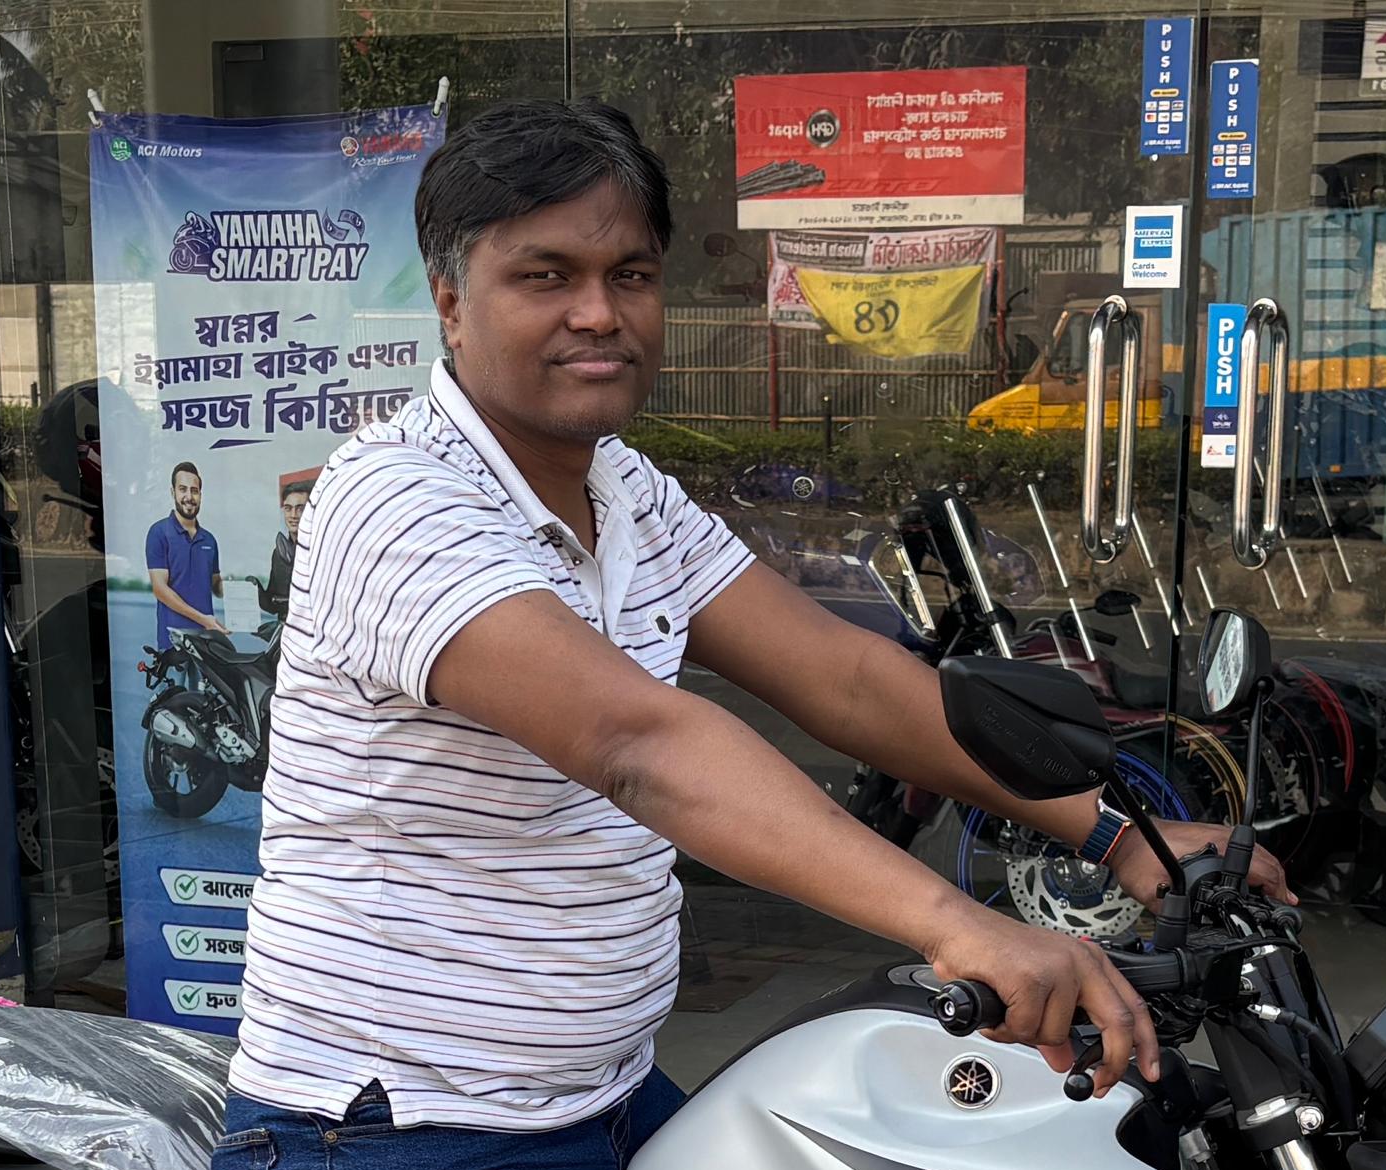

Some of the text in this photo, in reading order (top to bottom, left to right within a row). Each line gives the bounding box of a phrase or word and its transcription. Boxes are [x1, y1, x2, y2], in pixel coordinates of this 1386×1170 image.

[1159, 24, 1172, 83] PUSH
[1227, 67, 1240, 127] PUSH
[137, 146, 202, 158] ACI Motors
[215, 212, 324, 247] YAMAHA
[211, 245, 368, 280] SMART PAY
[1132, 262, 1155, 270] Cards
[1132, 270, 1168, 278] Welcome
[195, 310, 280, 347] স্বপ্নের
[254, 341, 339, 378] বাইক
[347, 340, 419, 370] এখন
[1215, 318, 1235, 395] PUSH
[162, 394, 253, 432] সহজ
